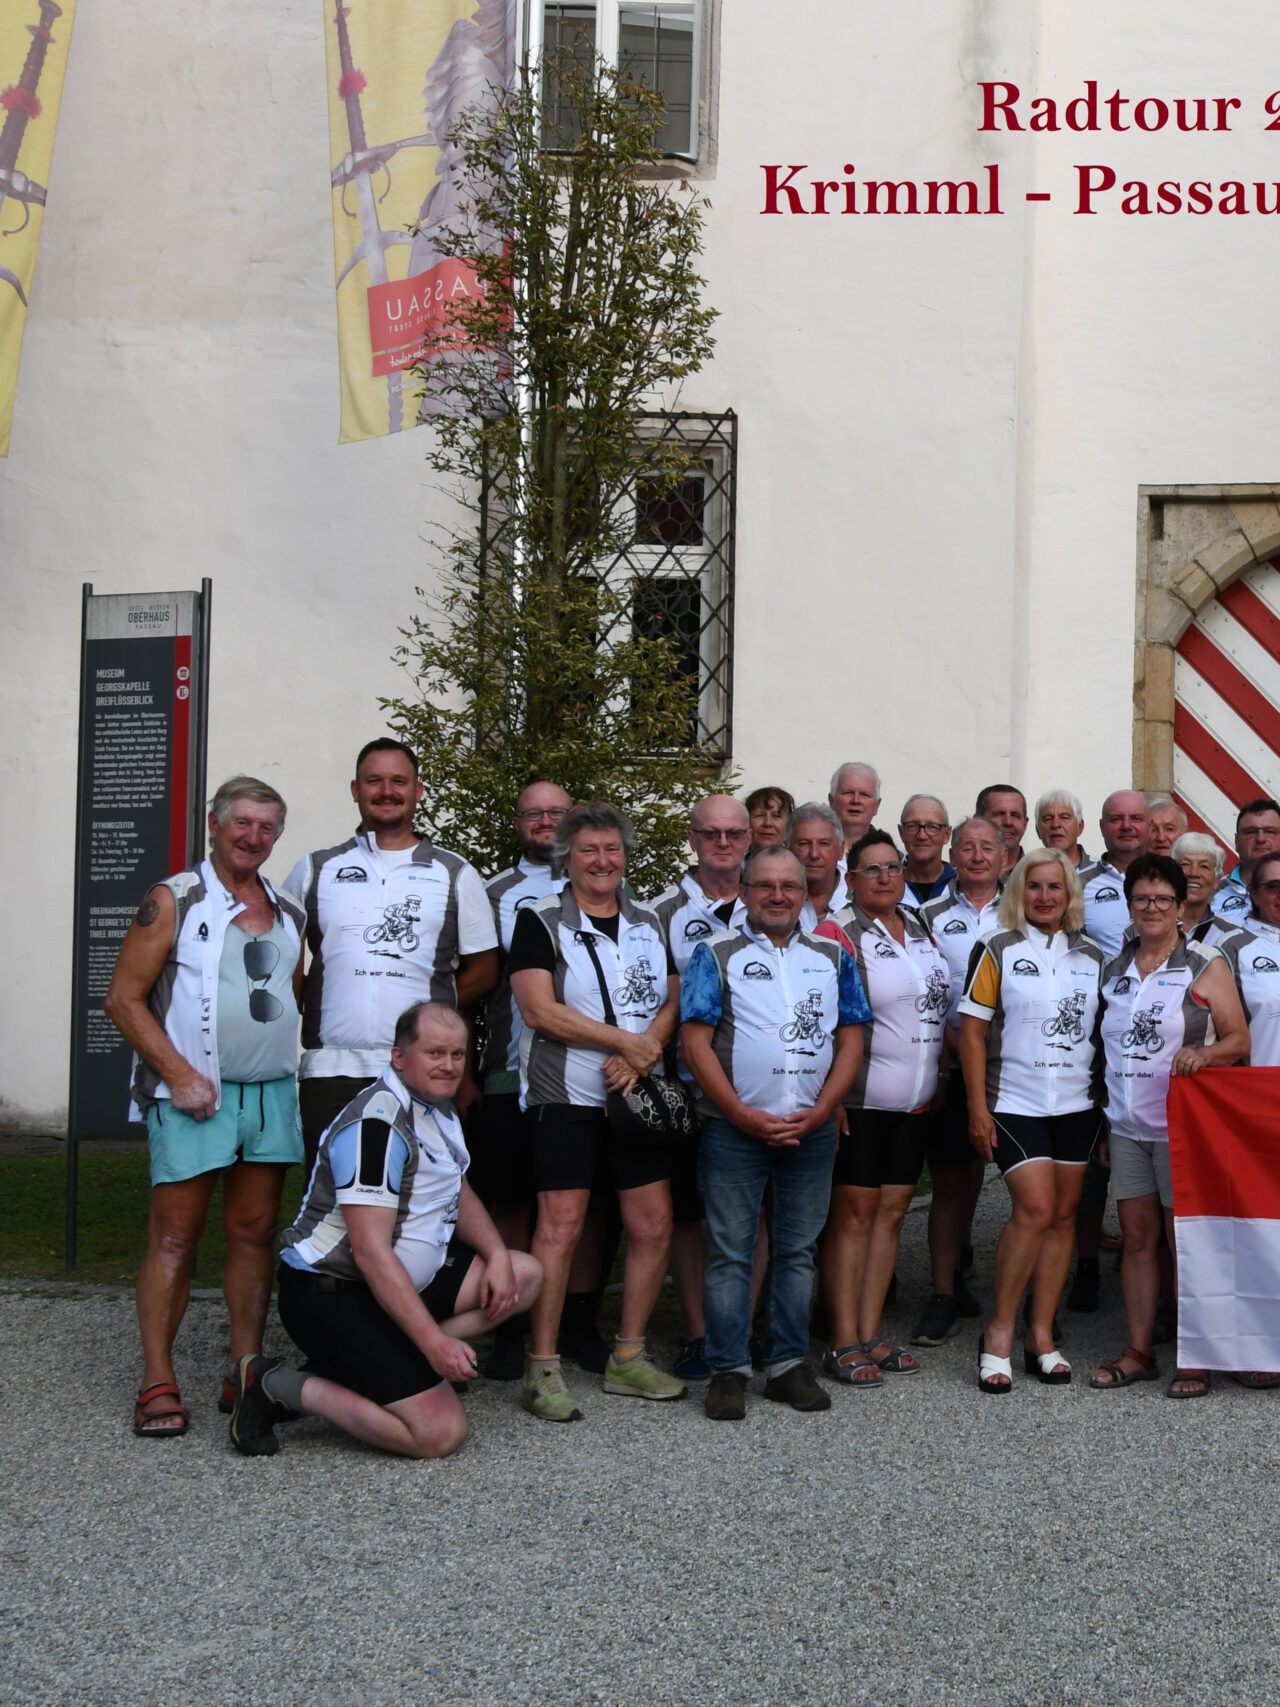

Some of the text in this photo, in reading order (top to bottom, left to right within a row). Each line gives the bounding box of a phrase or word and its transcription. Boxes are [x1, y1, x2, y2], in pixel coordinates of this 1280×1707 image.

[128, 610, 170, 623] OBERHAUS
[96, 668, 125, 678] MUSEUM
[96, 681, 151, 692] GEORGSKAPELLE
[95, 695, 154, 706] DREIFLÜSSEBLICK
[772, 1067, 785, 1075] Ich
